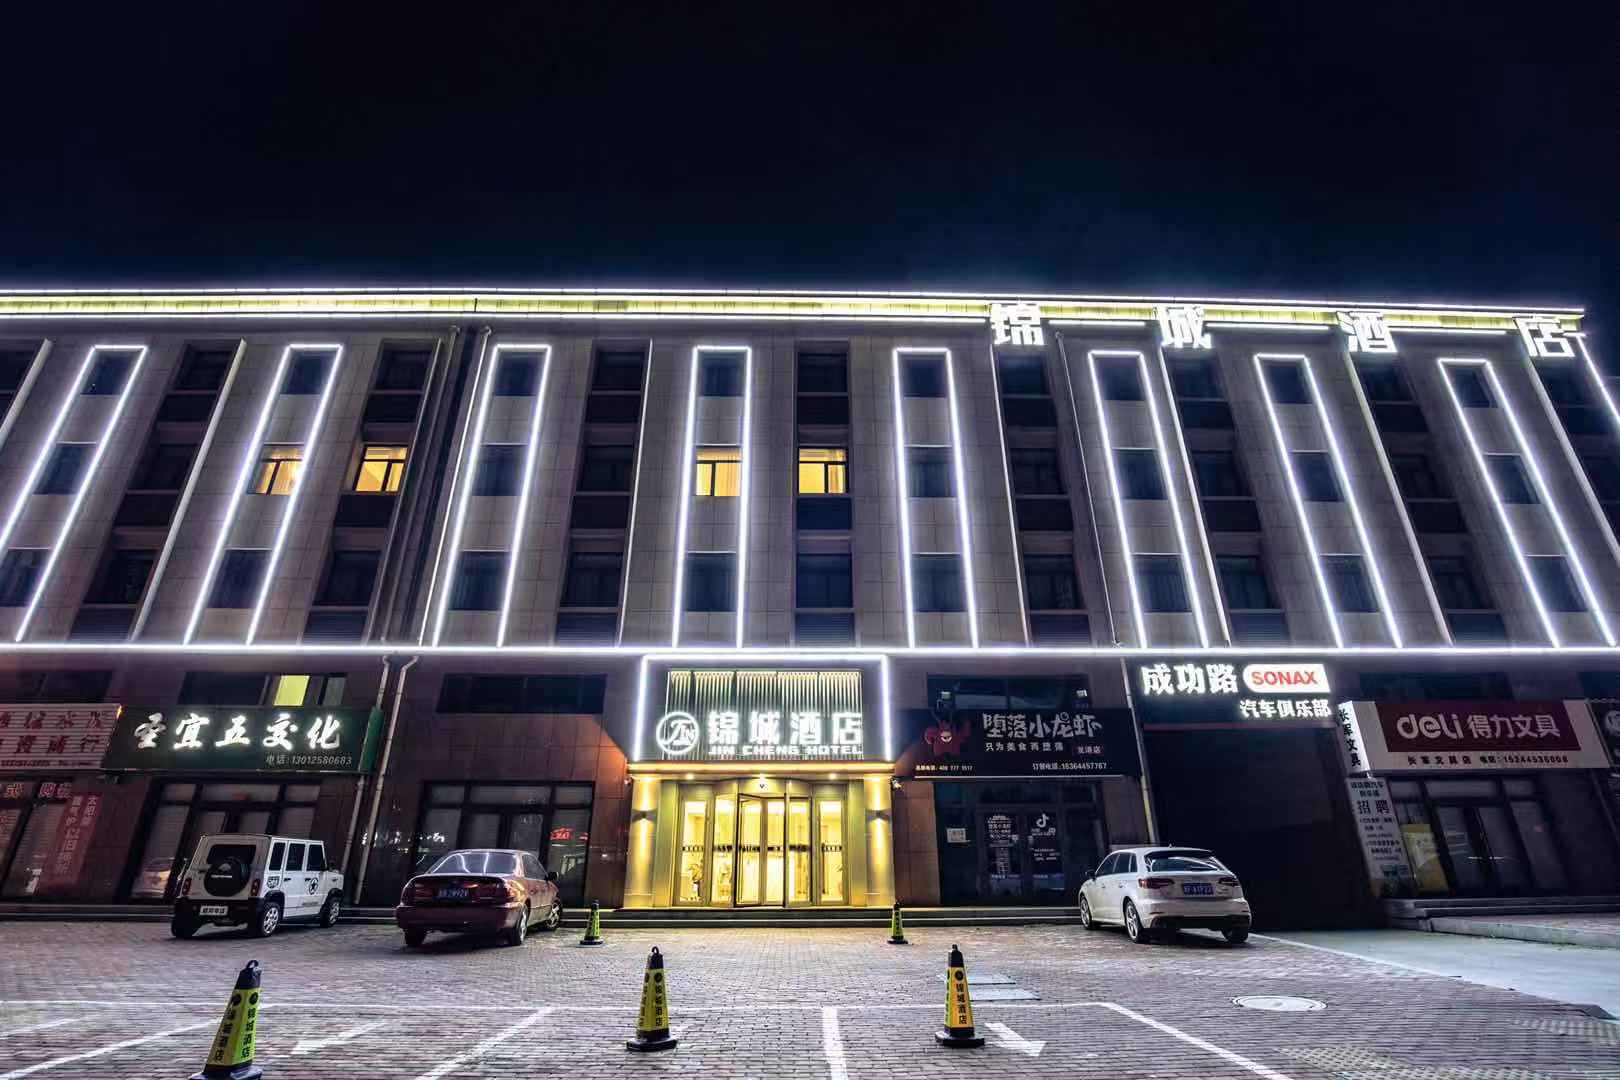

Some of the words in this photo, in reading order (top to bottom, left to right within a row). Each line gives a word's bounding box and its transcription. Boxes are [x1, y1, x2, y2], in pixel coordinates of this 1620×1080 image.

[1141, 664, 1239, 695] 成功路
[1251, 671, 1318, 685] SONAX
[1240, 699, 1331, 718] 汽车俱乐部
[708, 711, 862, 745] 锦城酒店
[982, 711, 1103, 738] 堕落小龙虾
[1396, 713, 1464, 739] deli
[1467, 714, 1561, 739] 得力文具
[708, 745, 736, 756] JIN
[742, 745, 800, 756] CHENG
[806, 745, 863, 756] HOTEL
[955, 983, 967, 1025] 锦城酒店
